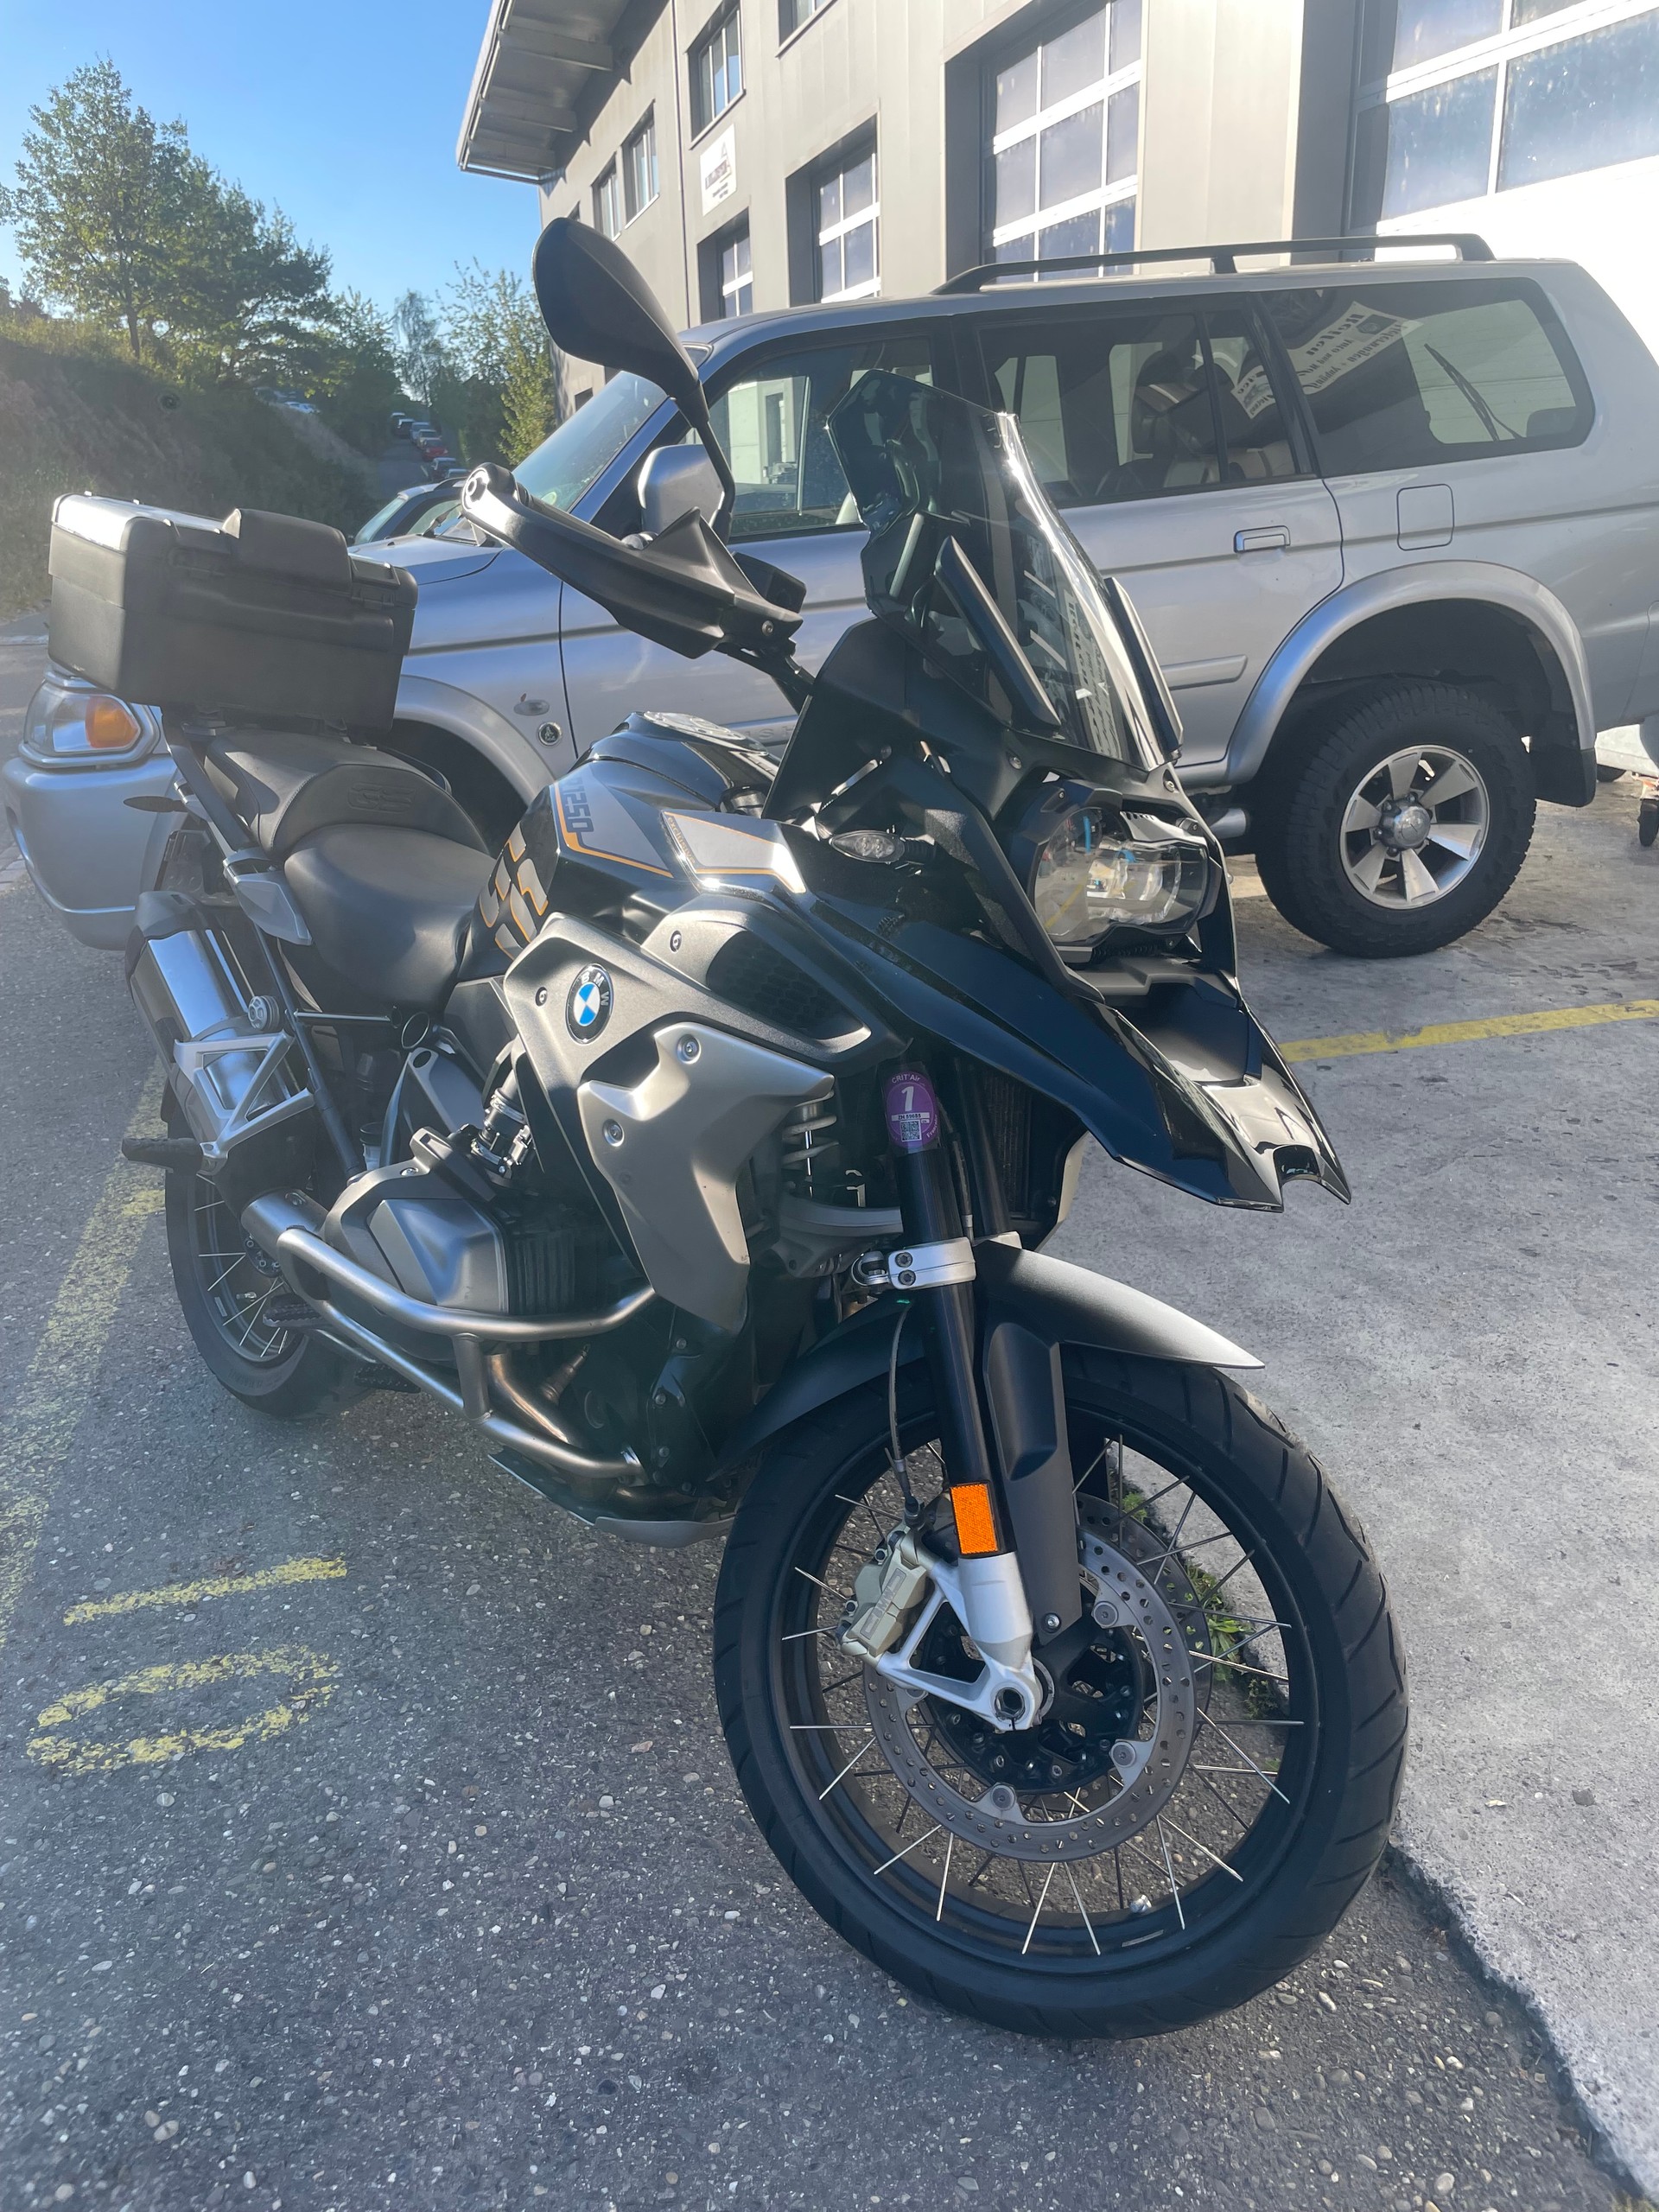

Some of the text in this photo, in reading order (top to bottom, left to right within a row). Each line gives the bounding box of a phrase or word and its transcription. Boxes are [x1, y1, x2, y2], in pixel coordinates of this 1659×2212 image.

[667, 817, 696, 864] exclusive
[581, 971, 609, 1006] BMW
[901, 1086, 914, 1112] 1
